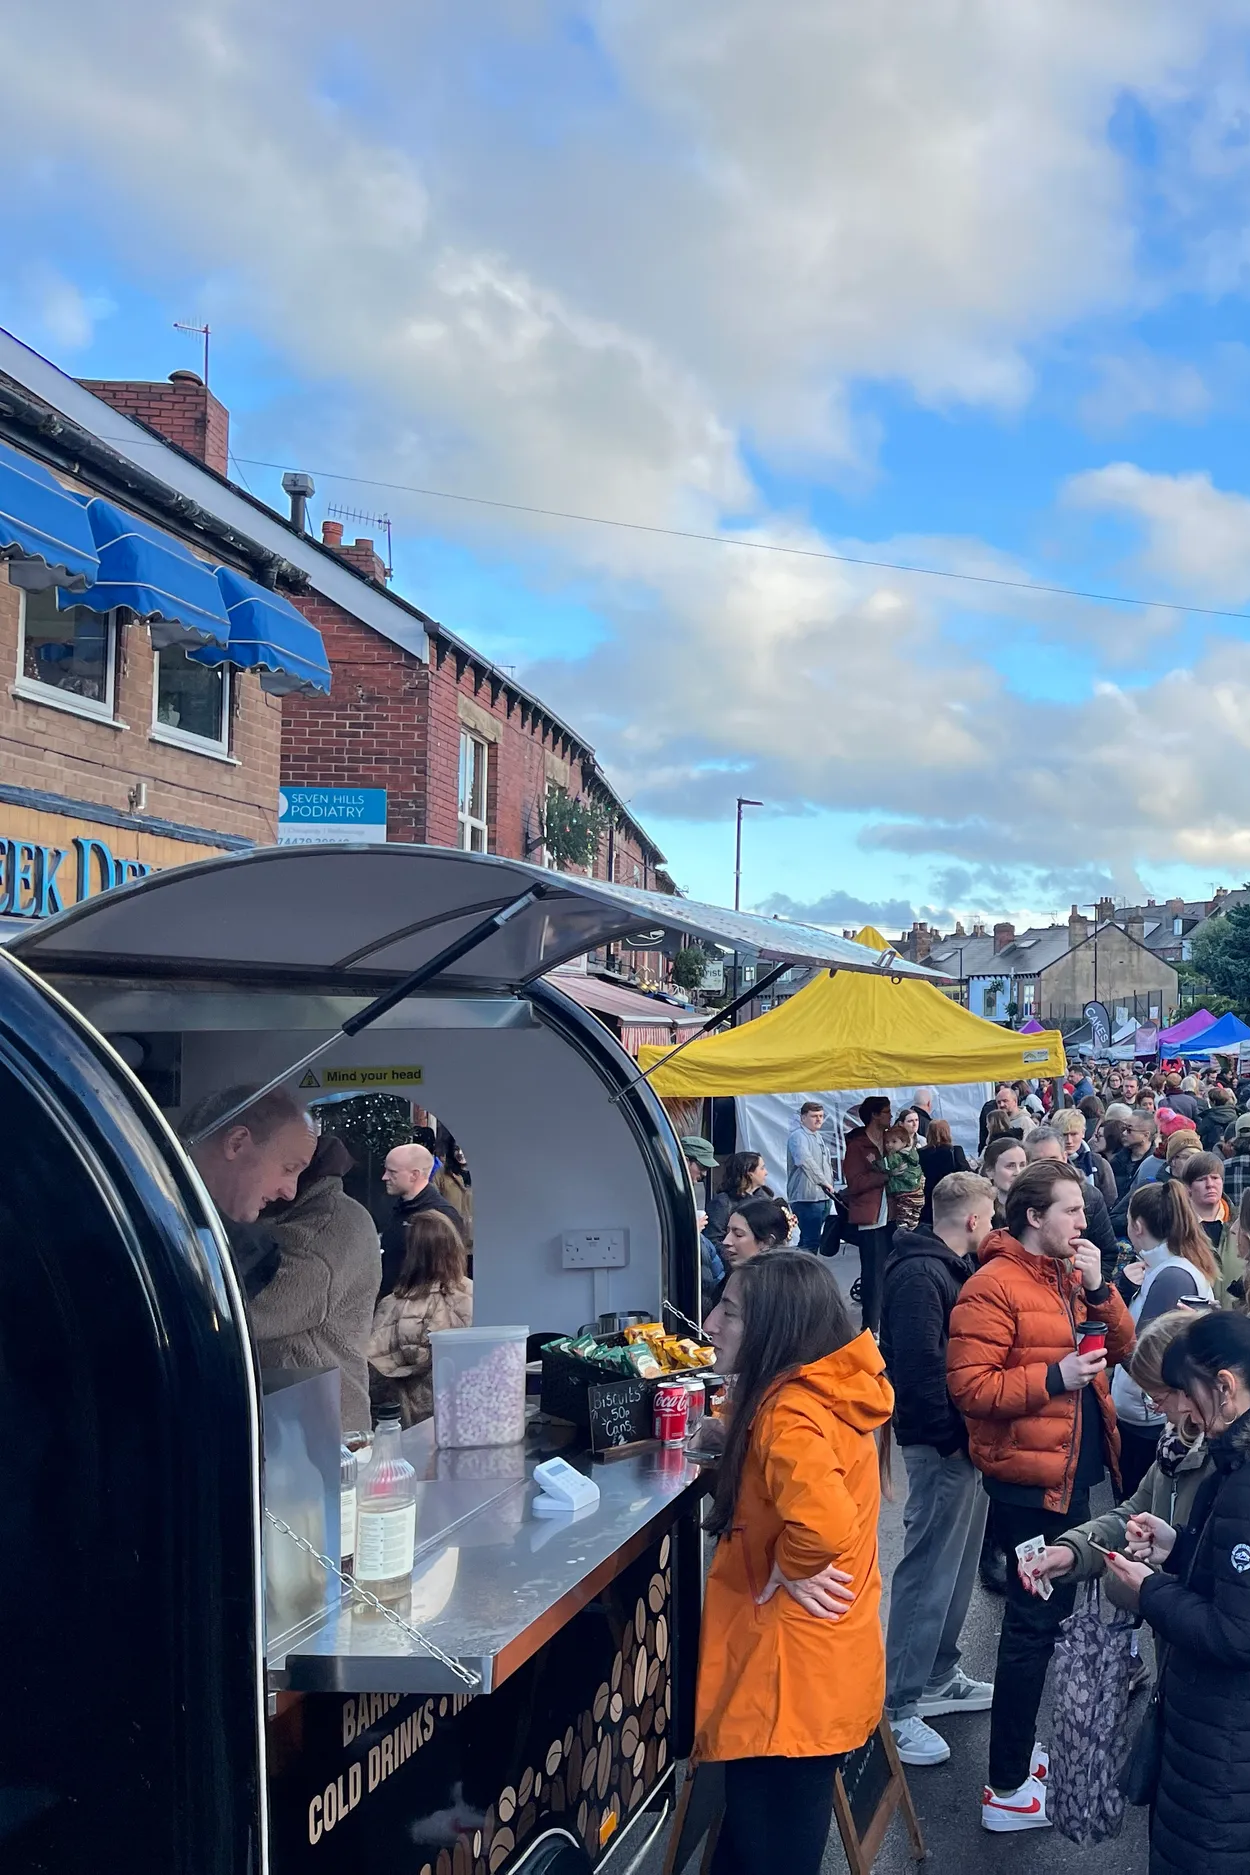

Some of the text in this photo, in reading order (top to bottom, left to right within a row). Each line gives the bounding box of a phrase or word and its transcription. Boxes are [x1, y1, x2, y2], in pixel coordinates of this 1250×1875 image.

[291, 793, 365, 805] SEVEN HILLS
[291, 805, 365, 818] PODIATRY
[1085, 1007, 1109, 1043] CAKES
[327, 1069, 421, 1083] Mind your head
[611, 1406, 630, 1421] 50p
[605, 1420, 632, 1437] Cans
[308, 1697, 435, 1846] COLD DRINKS
